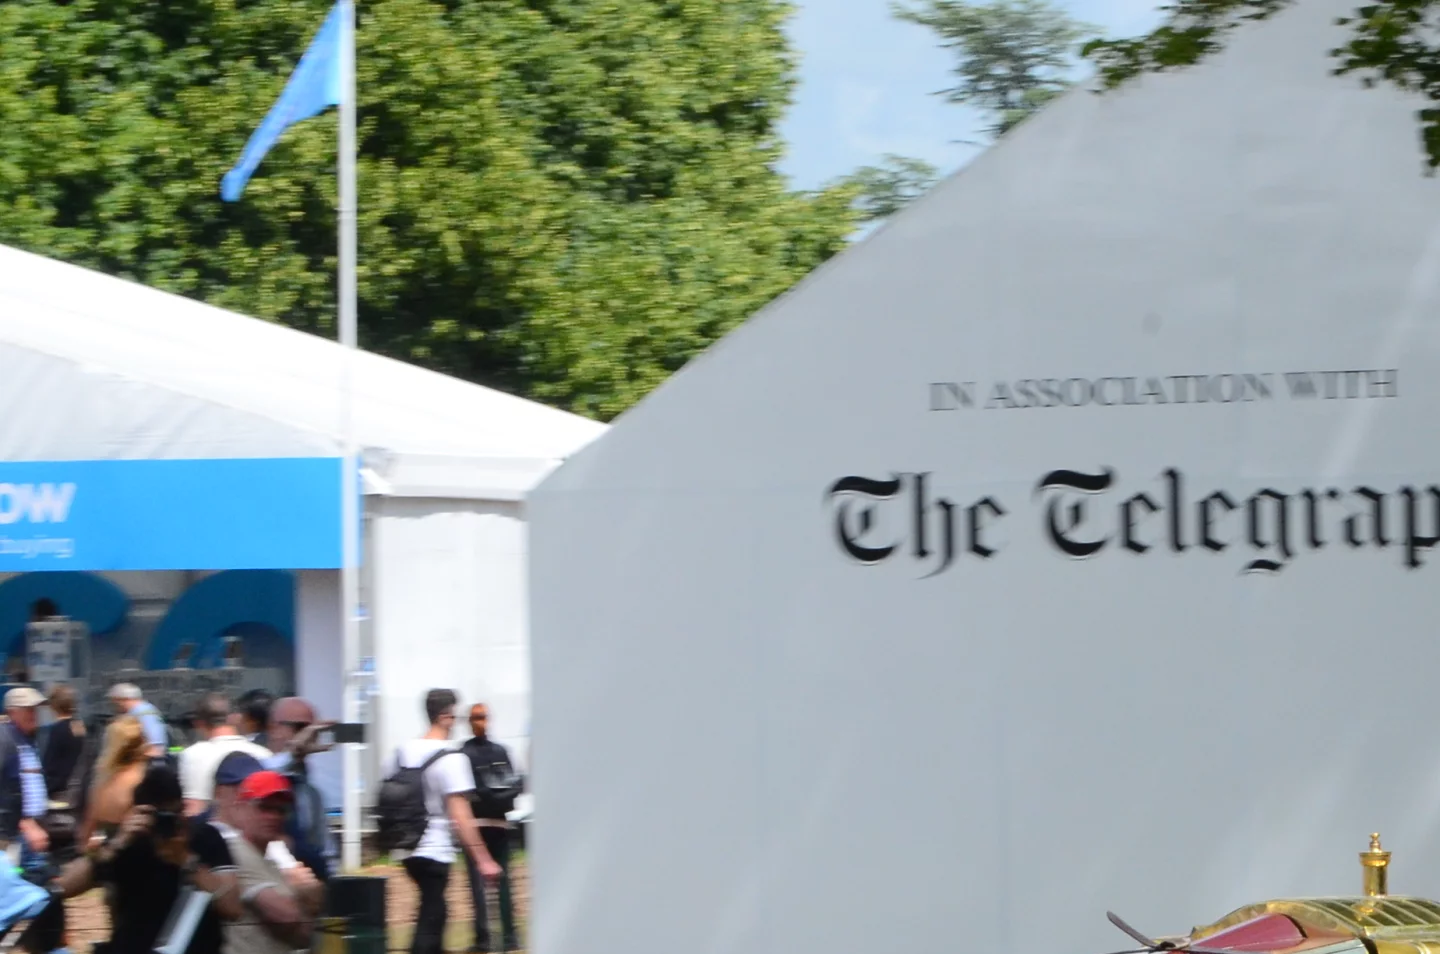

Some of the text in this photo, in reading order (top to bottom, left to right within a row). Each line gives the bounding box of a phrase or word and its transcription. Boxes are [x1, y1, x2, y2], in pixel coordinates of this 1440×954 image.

[928, 369, 1400, 412] IN ASSOCIATION WITH
[822, 470, 1006, 579] The
